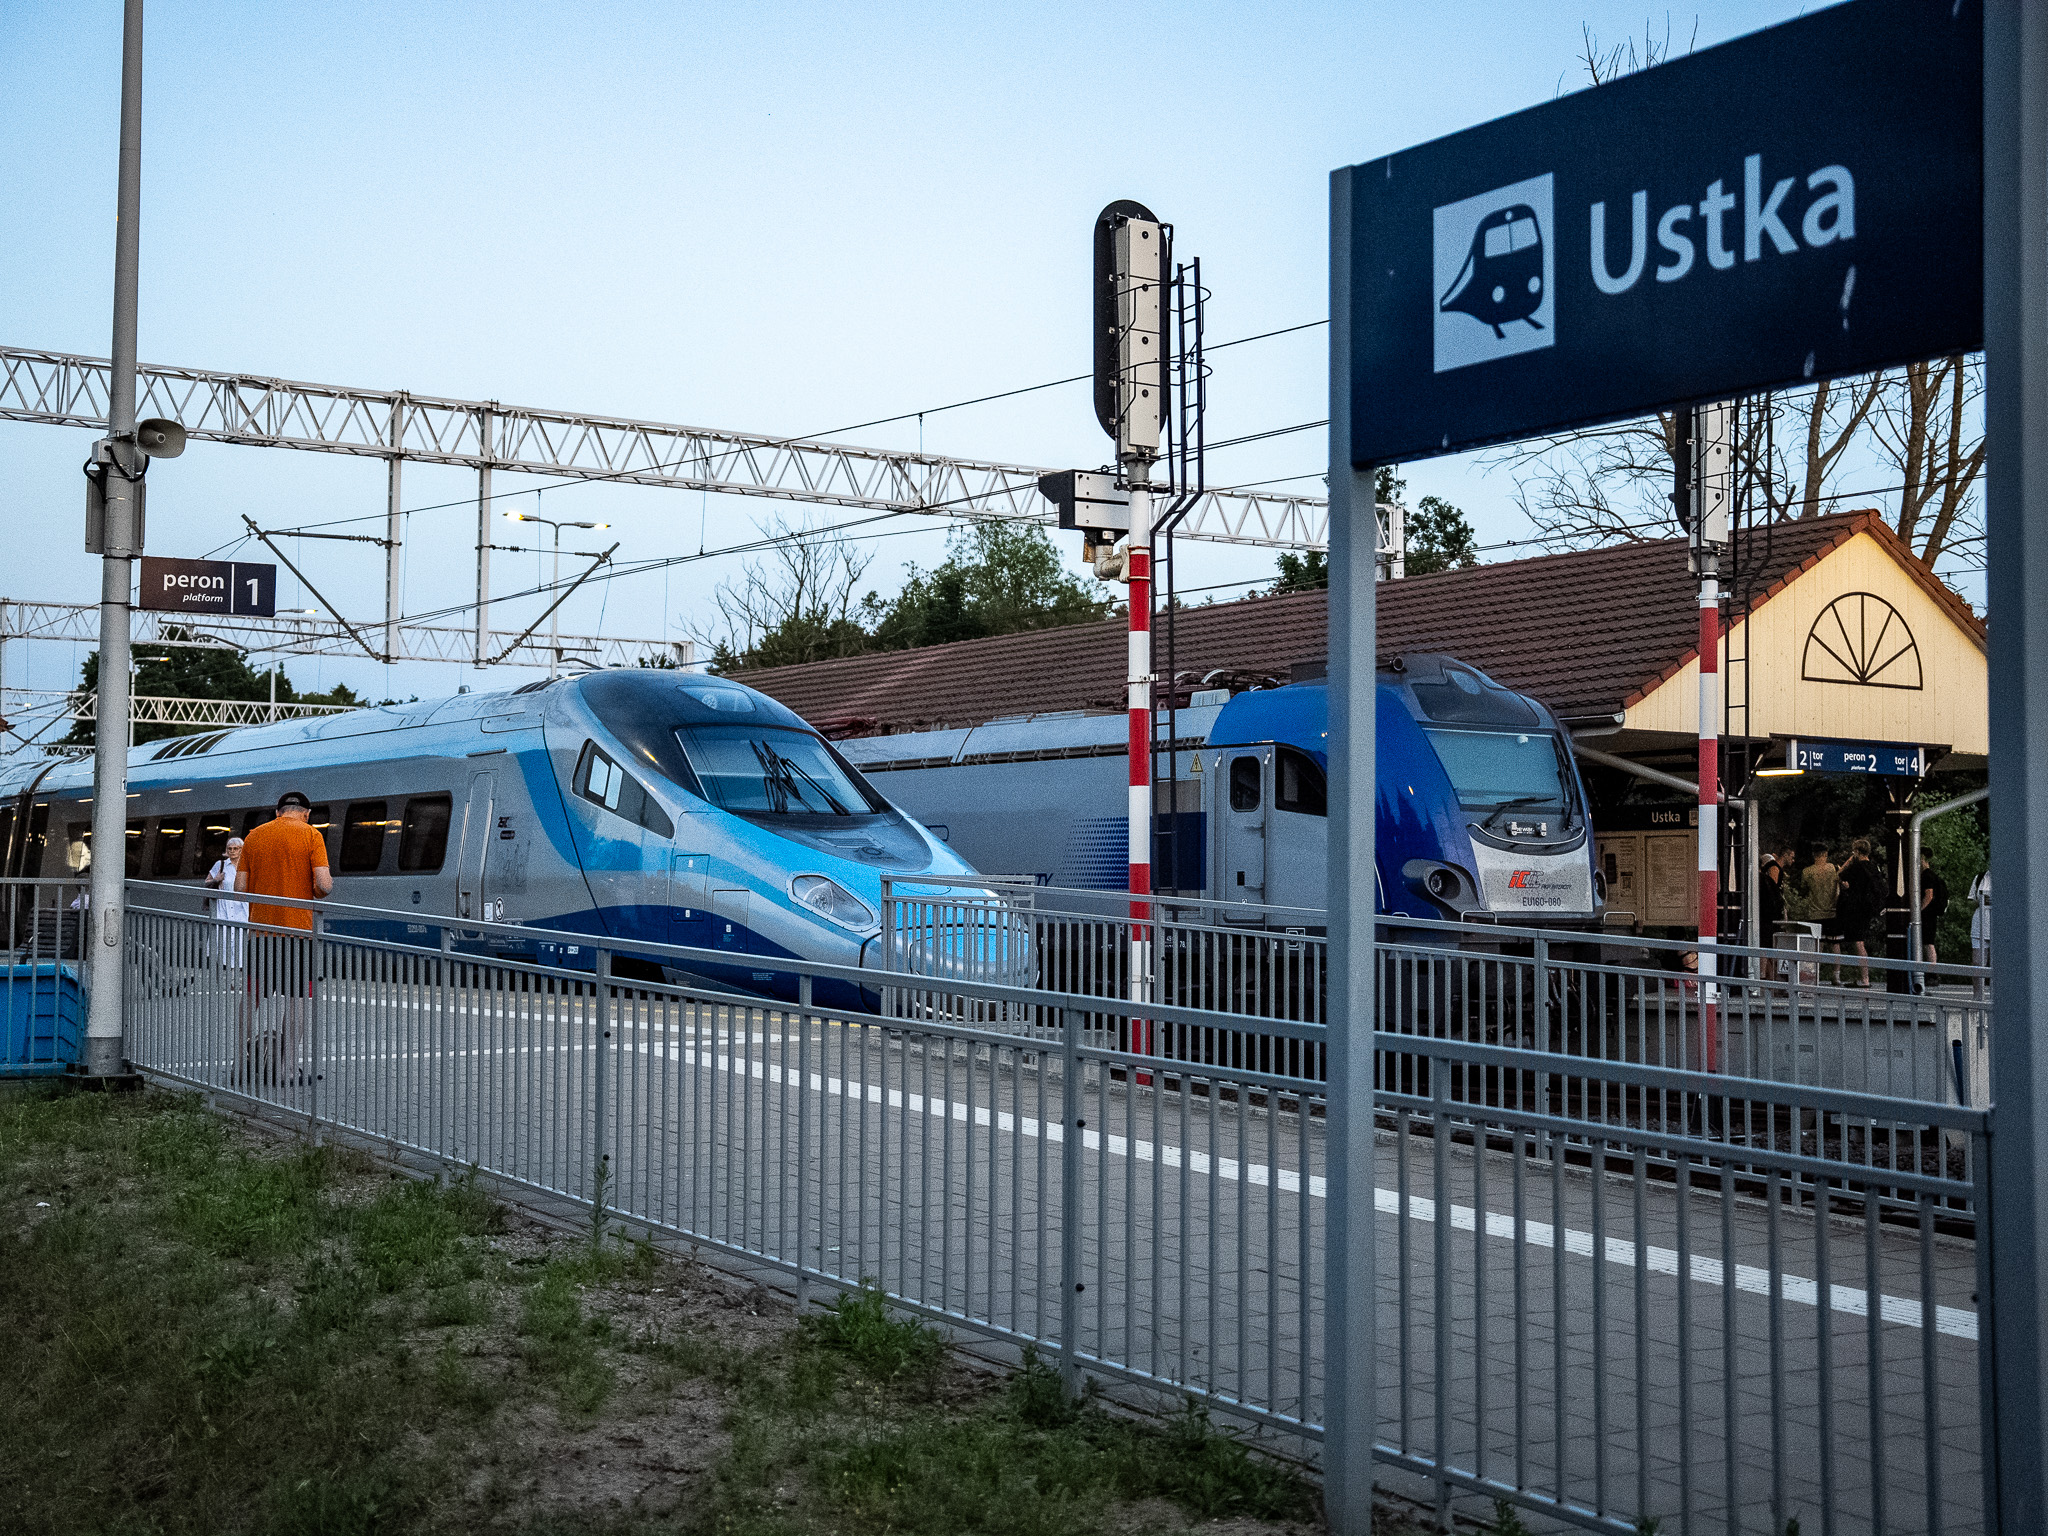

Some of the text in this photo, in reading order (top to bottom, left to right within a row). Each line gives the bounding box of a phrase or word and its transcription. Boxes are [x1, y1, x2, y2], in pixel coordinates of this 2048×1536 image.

[1590, 153, 1856, 296] Ustka
[163, 573, 258, 606] peron 1
[182, 593, 223, 603] platform
[1800, 750, 1823, 766] 2 tor
[1844, 752, 1877, 772] peron 2
[1894, 756, 1918, 772] tor 4
[1651, 810, 1681, 823] Ustka
[1522, 896, 1562, 907] EU160-080
